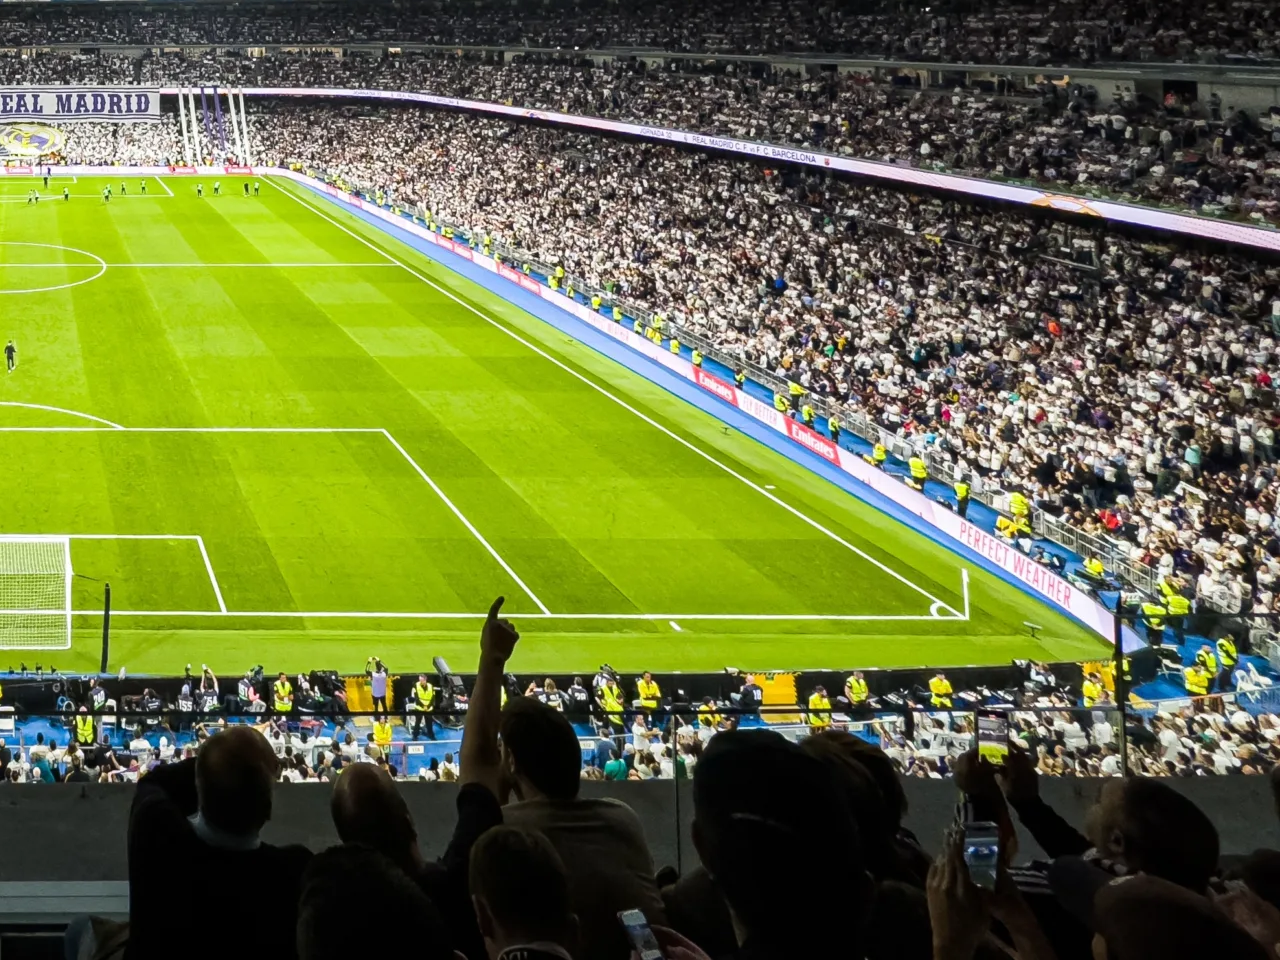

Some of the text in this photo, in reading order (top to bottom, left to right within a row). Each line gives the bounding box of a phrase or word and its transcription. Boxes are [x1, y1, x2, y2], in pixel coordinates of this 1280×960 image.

[55, 93, 150, 114] MADRID
[692, 135, 707, 145] REAL
[709, 138, 734, 149] MADRID
[772, 147, 817, 163] BARCELONA
[698, 373, 733, 401] Emirates
[743, 395, 778, 425] FLY BETTER
[791, 424, 834, 459] Emirates
[960, 520, 1071, 609] PERFECT WEATHER
